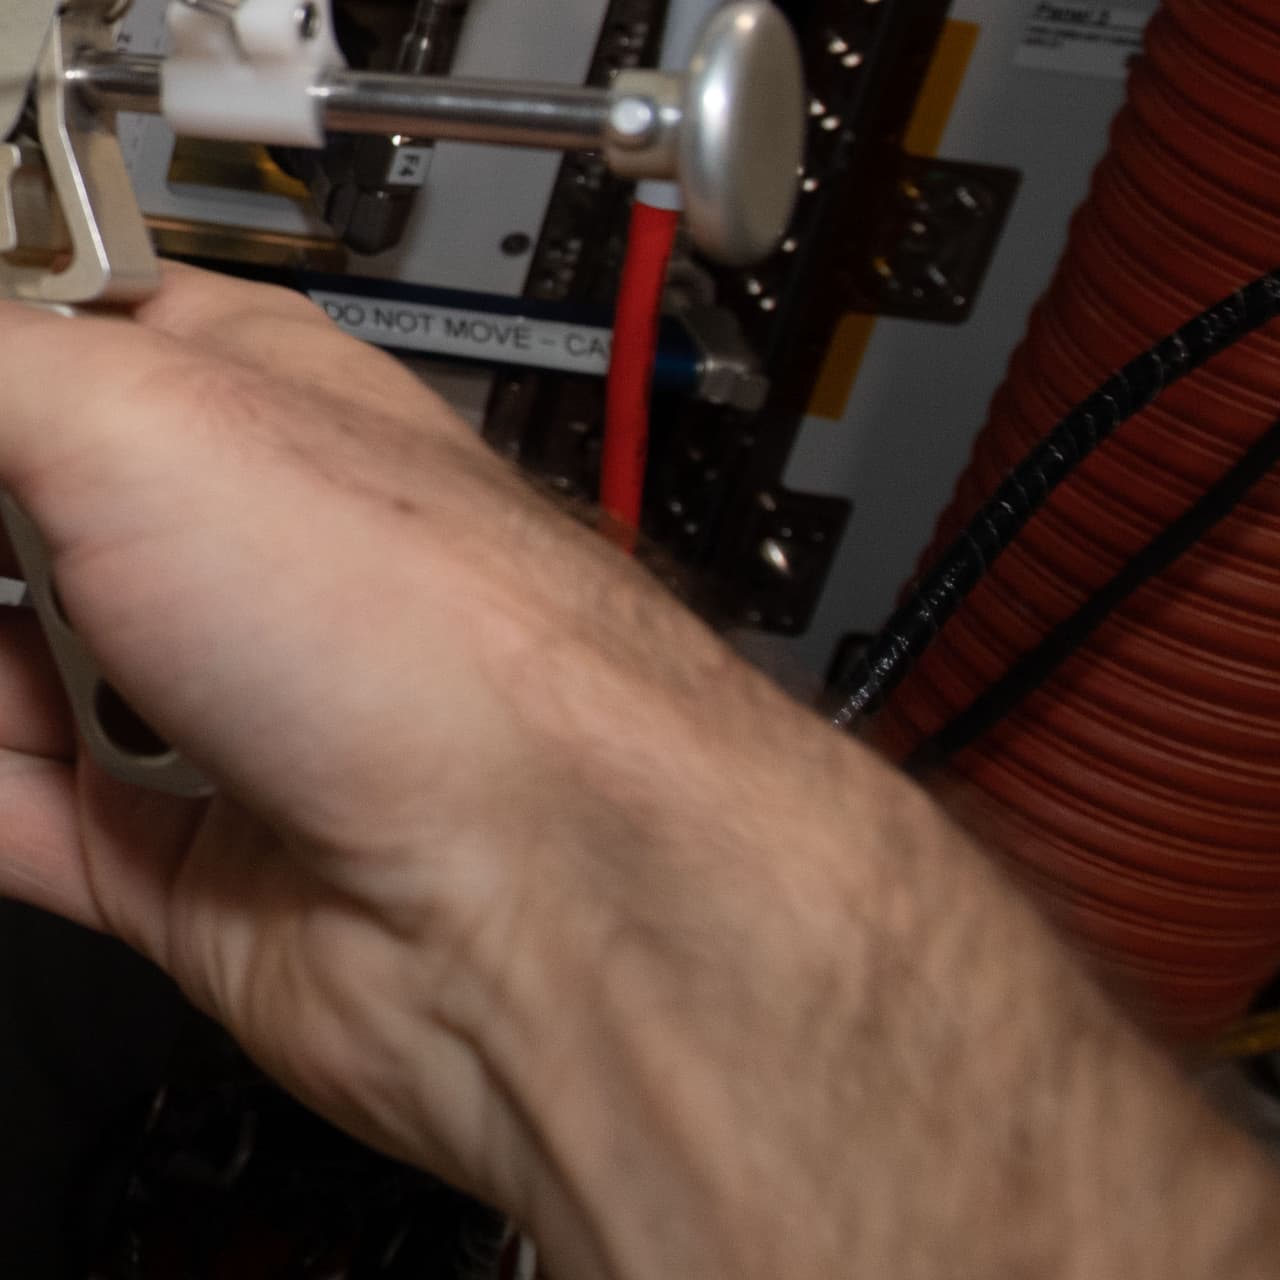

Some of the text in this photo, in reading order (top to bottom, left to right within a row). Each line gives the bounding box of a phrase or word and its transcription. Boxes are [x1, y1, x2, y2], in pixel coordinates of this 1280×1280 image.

[322, 299, 365, 327] DO
[374, 308, 434, 334] NOT
[444, 316, 533, 350] MOVE
